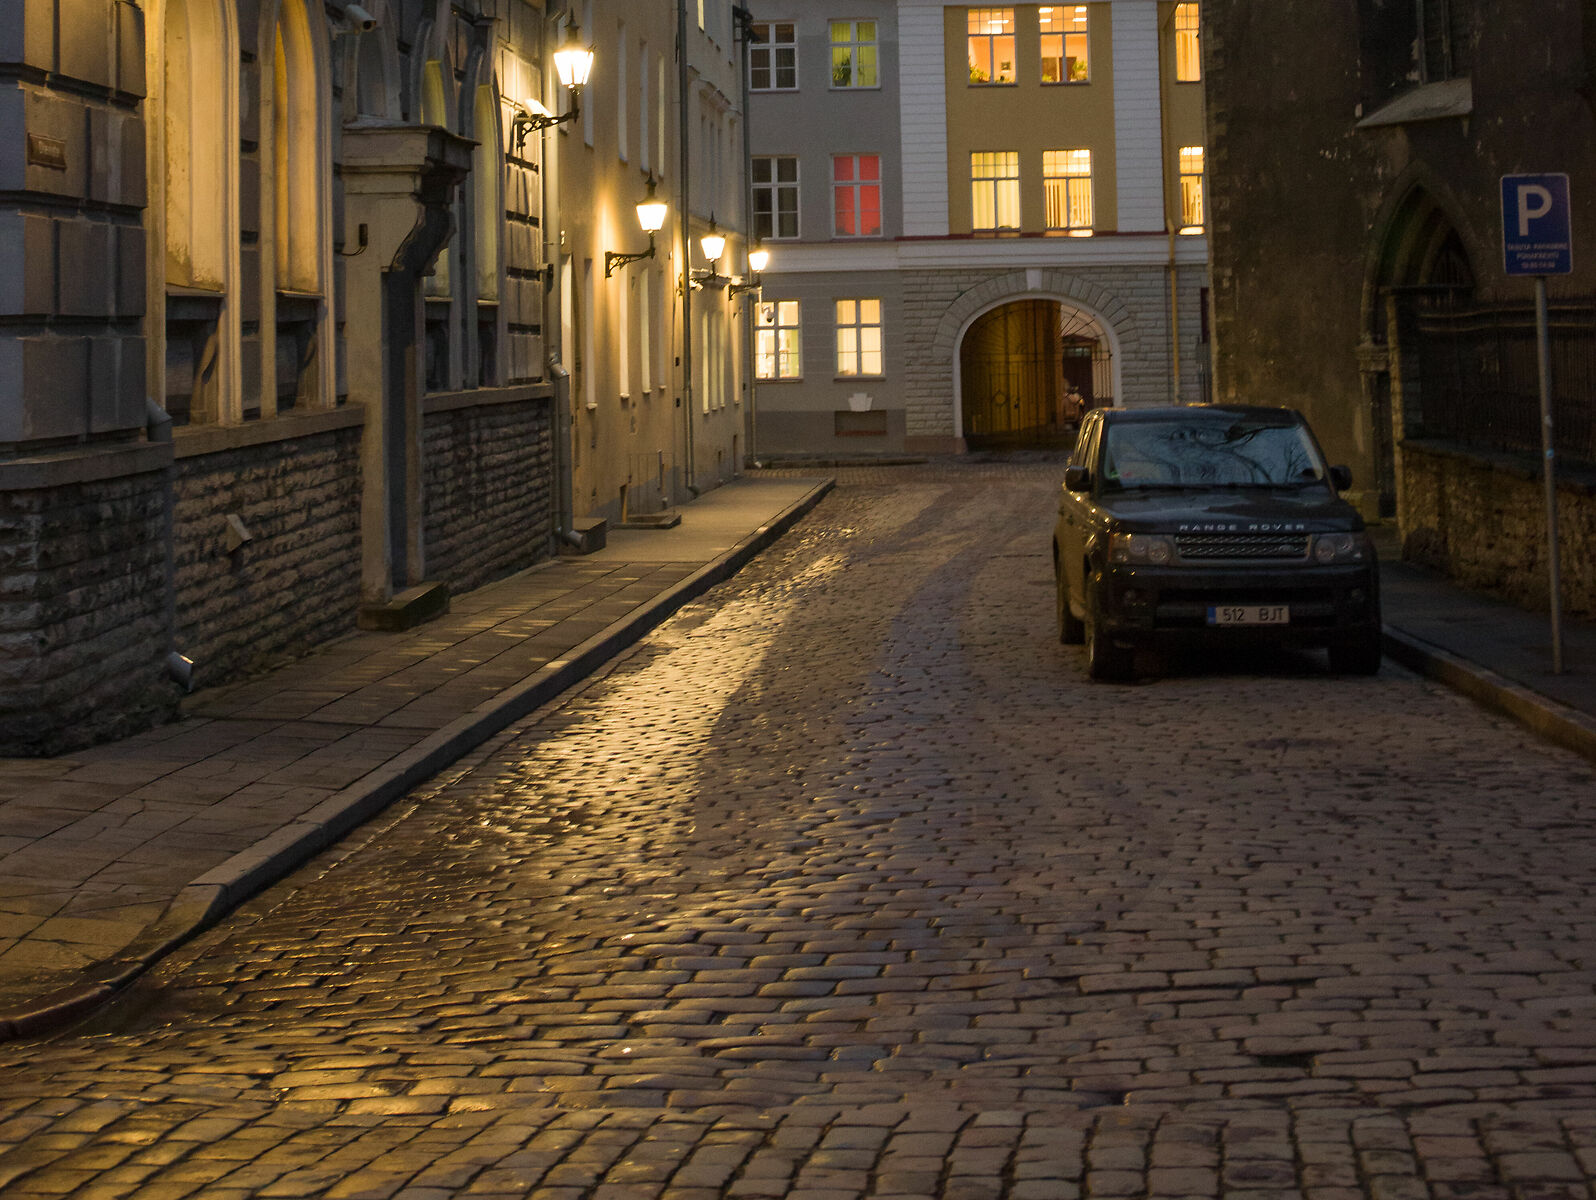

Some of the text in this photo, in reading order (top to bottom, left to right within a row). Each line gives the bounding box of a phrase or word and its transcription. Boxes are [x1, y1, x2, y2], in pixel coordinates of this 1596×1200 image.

[1517, 184, 1553, 237] P
[1222, 608, 1245, 621] 512
[1258, 608, 1284, 621] BJT
